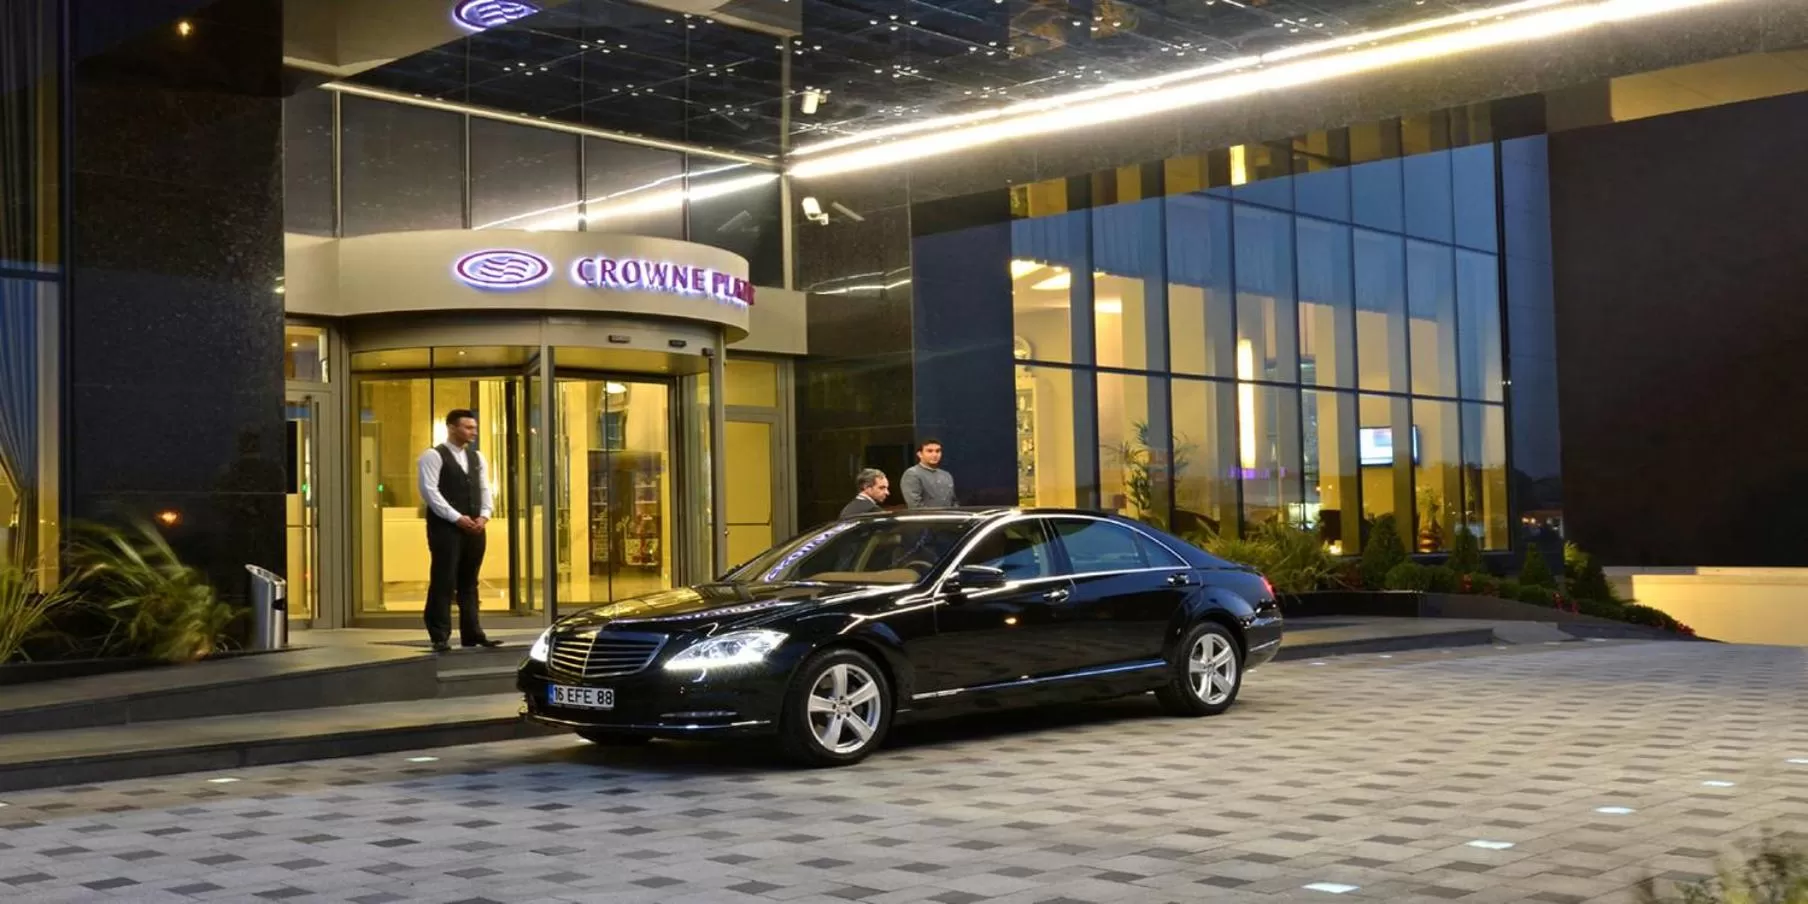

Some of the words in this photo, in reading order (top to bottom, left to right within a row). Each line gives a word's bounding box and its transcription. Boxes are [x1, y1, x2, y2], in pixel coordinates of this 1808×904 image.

[576, 258, 705, 291] CROWNE
[712, 271, 755, 305] PLA
[554, 687, 564, 702] 16
[567, 688, 593, 704] EFE
[597, 690, 613, 705] 88
